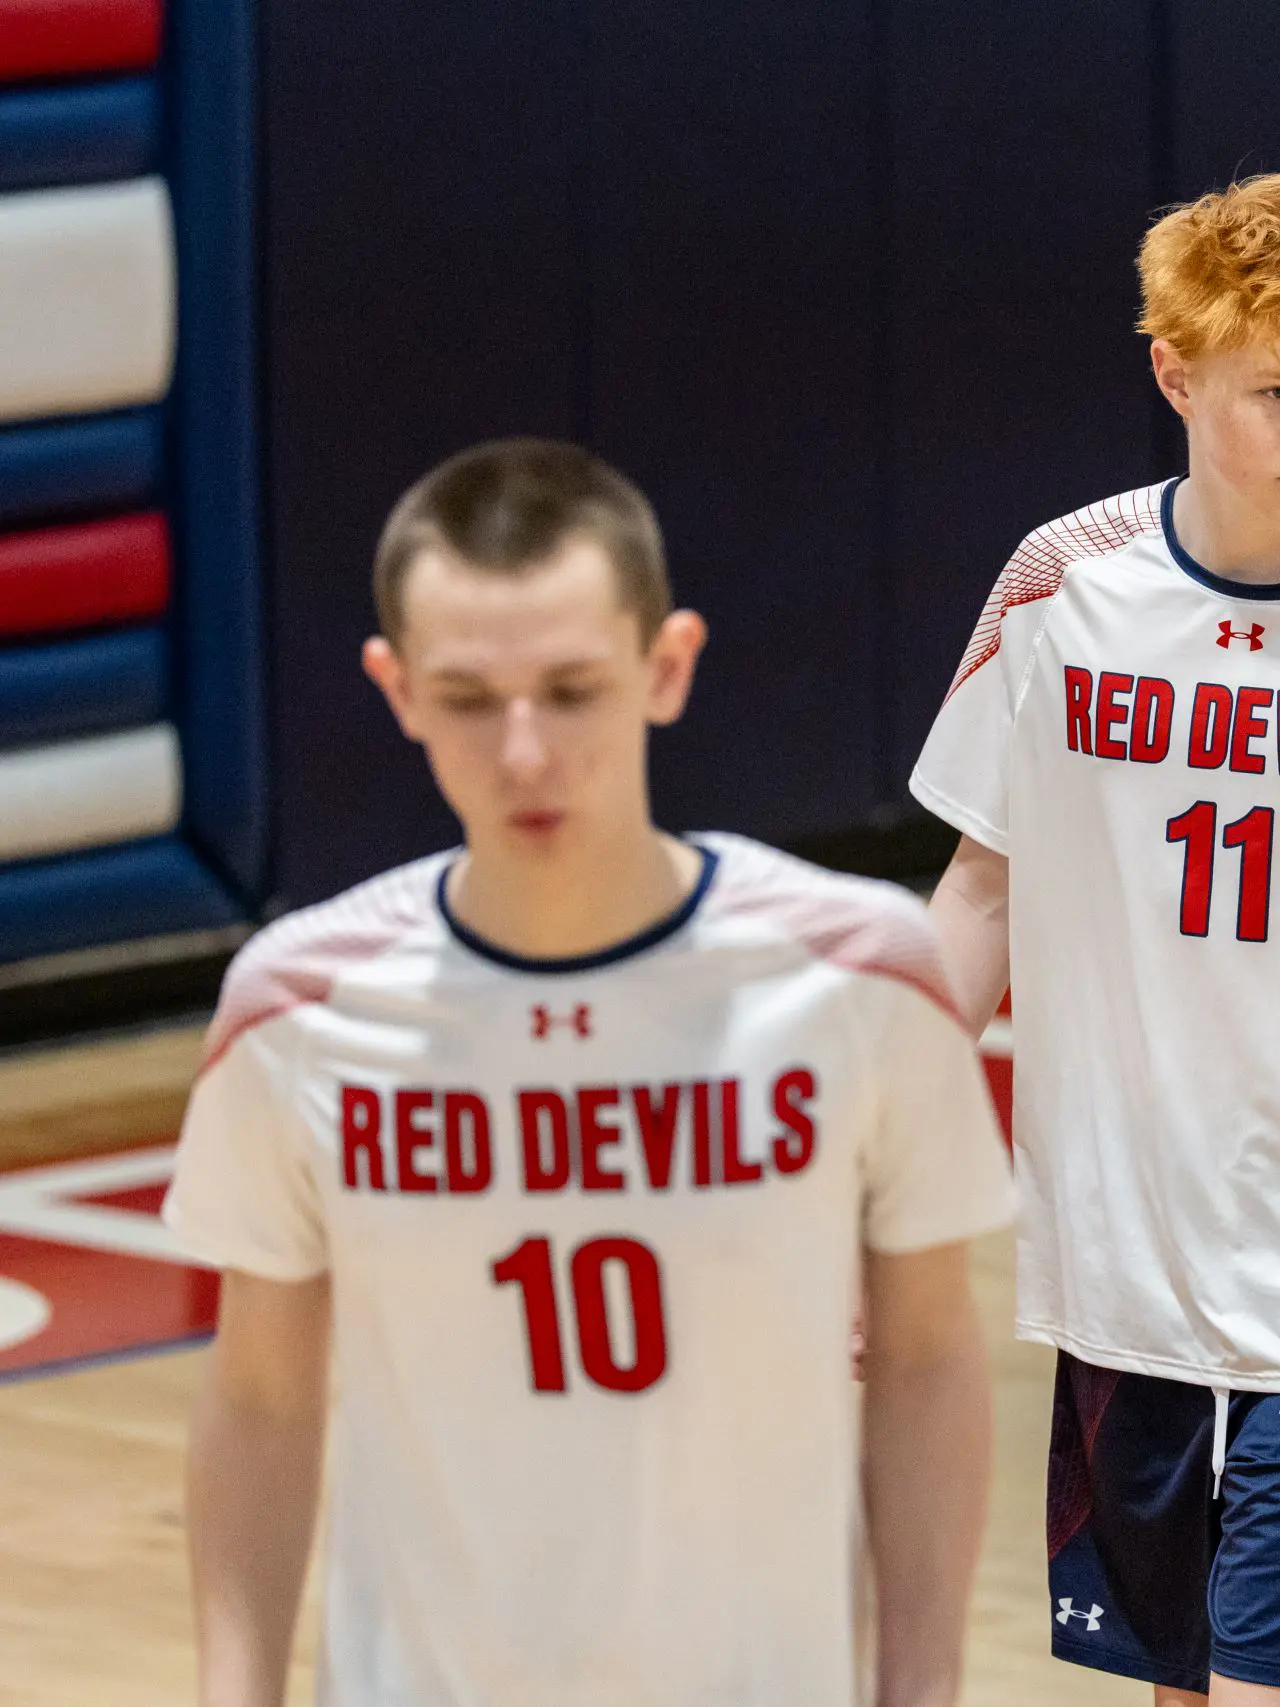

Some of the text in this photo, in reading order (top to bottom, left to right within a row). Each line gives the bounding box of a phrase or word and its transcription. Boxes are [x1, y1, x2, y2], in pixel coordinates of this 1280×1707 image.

[1064, 665, 1175, 764] RED
[1166, 801, 1274, 942] 11
[340, 1067, 818, 1195] RED DEVILS
[490, 1234, 669, 1395] 10
